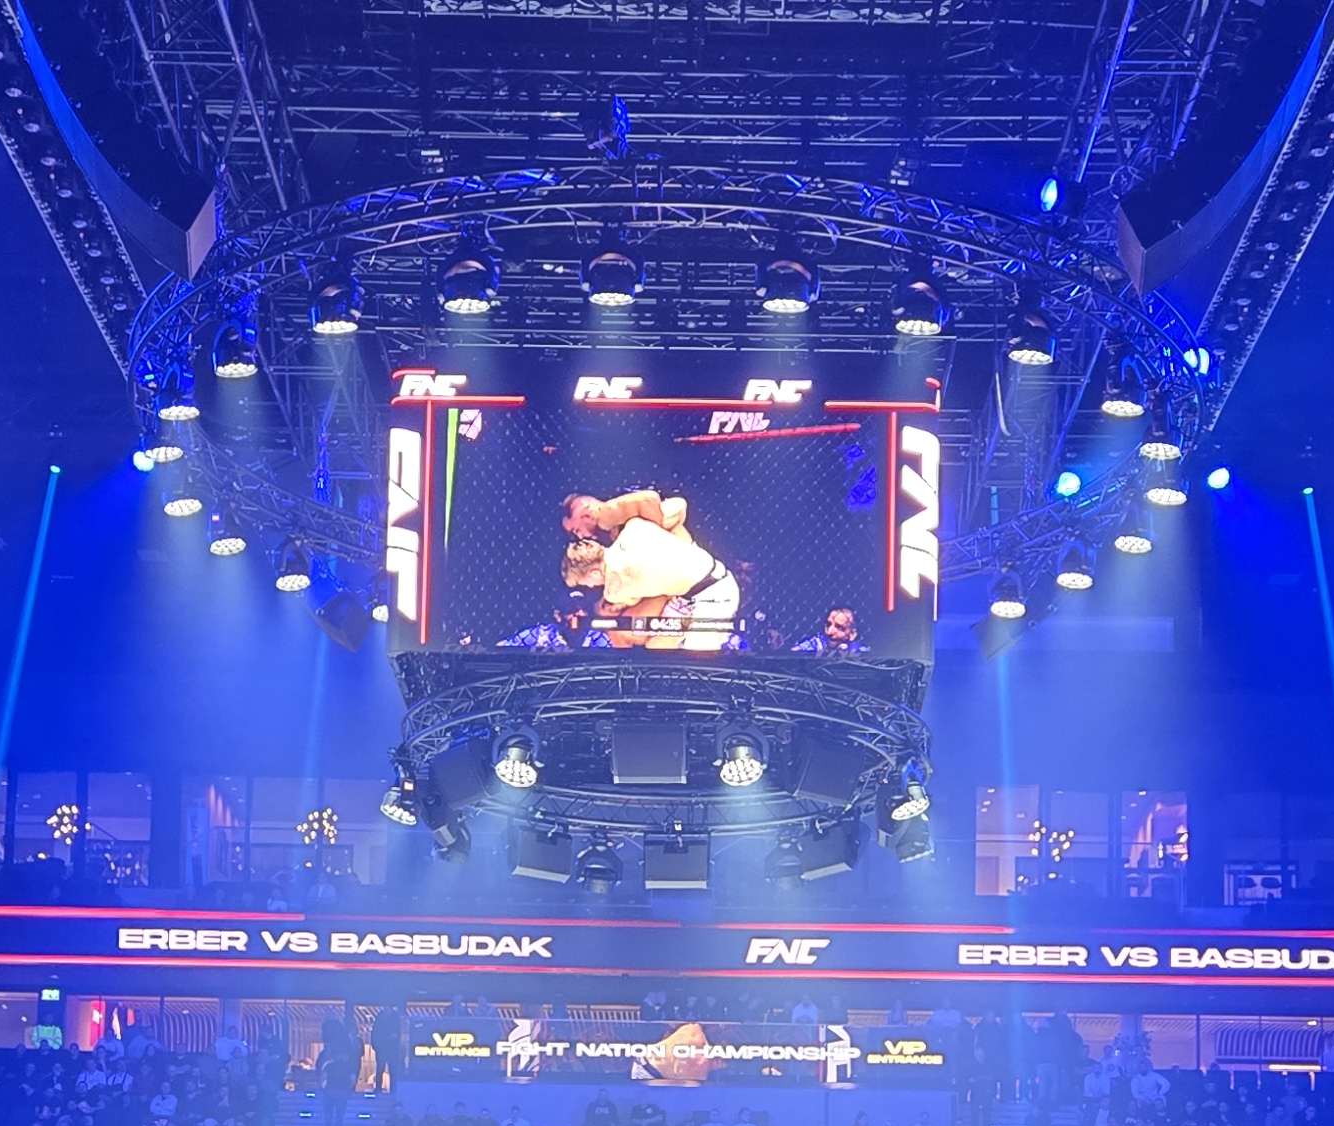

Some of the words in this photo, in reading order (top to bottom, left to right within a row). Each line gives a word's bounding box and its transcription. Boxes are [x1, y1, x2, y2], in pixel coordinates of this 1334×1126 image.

[399, 375, 467, 396] FNC
[574, 377, 642, 399] FNC
[744, 379, 812, 402] FNC
[900, 425, 940, 599] FNC
[386, 427, 422, 621] FNC
[118, 928, 247, 951] ERBER
[264, 932, 318, 953] VS
[330, 932, 552, 958] BASBUDAK
[745, 938, 830, 965] FNC
[958, 943, 1087, 967] ERBER
[1103, 947, 1158, 968] VS
[432, 1032, 474, 1048] VIP
[496, 1040, 569, 1058] FIGHT
[576, 1042, 666, 1059] NATION
[672, 1044, 862, 1062] CHAMPIONSHIP
[884, 1040, 927, 1055] VIP
[415, 1047, 491, 1057] ENTRANCE
[867, 1054, 943, 1065] ENTRANCE
